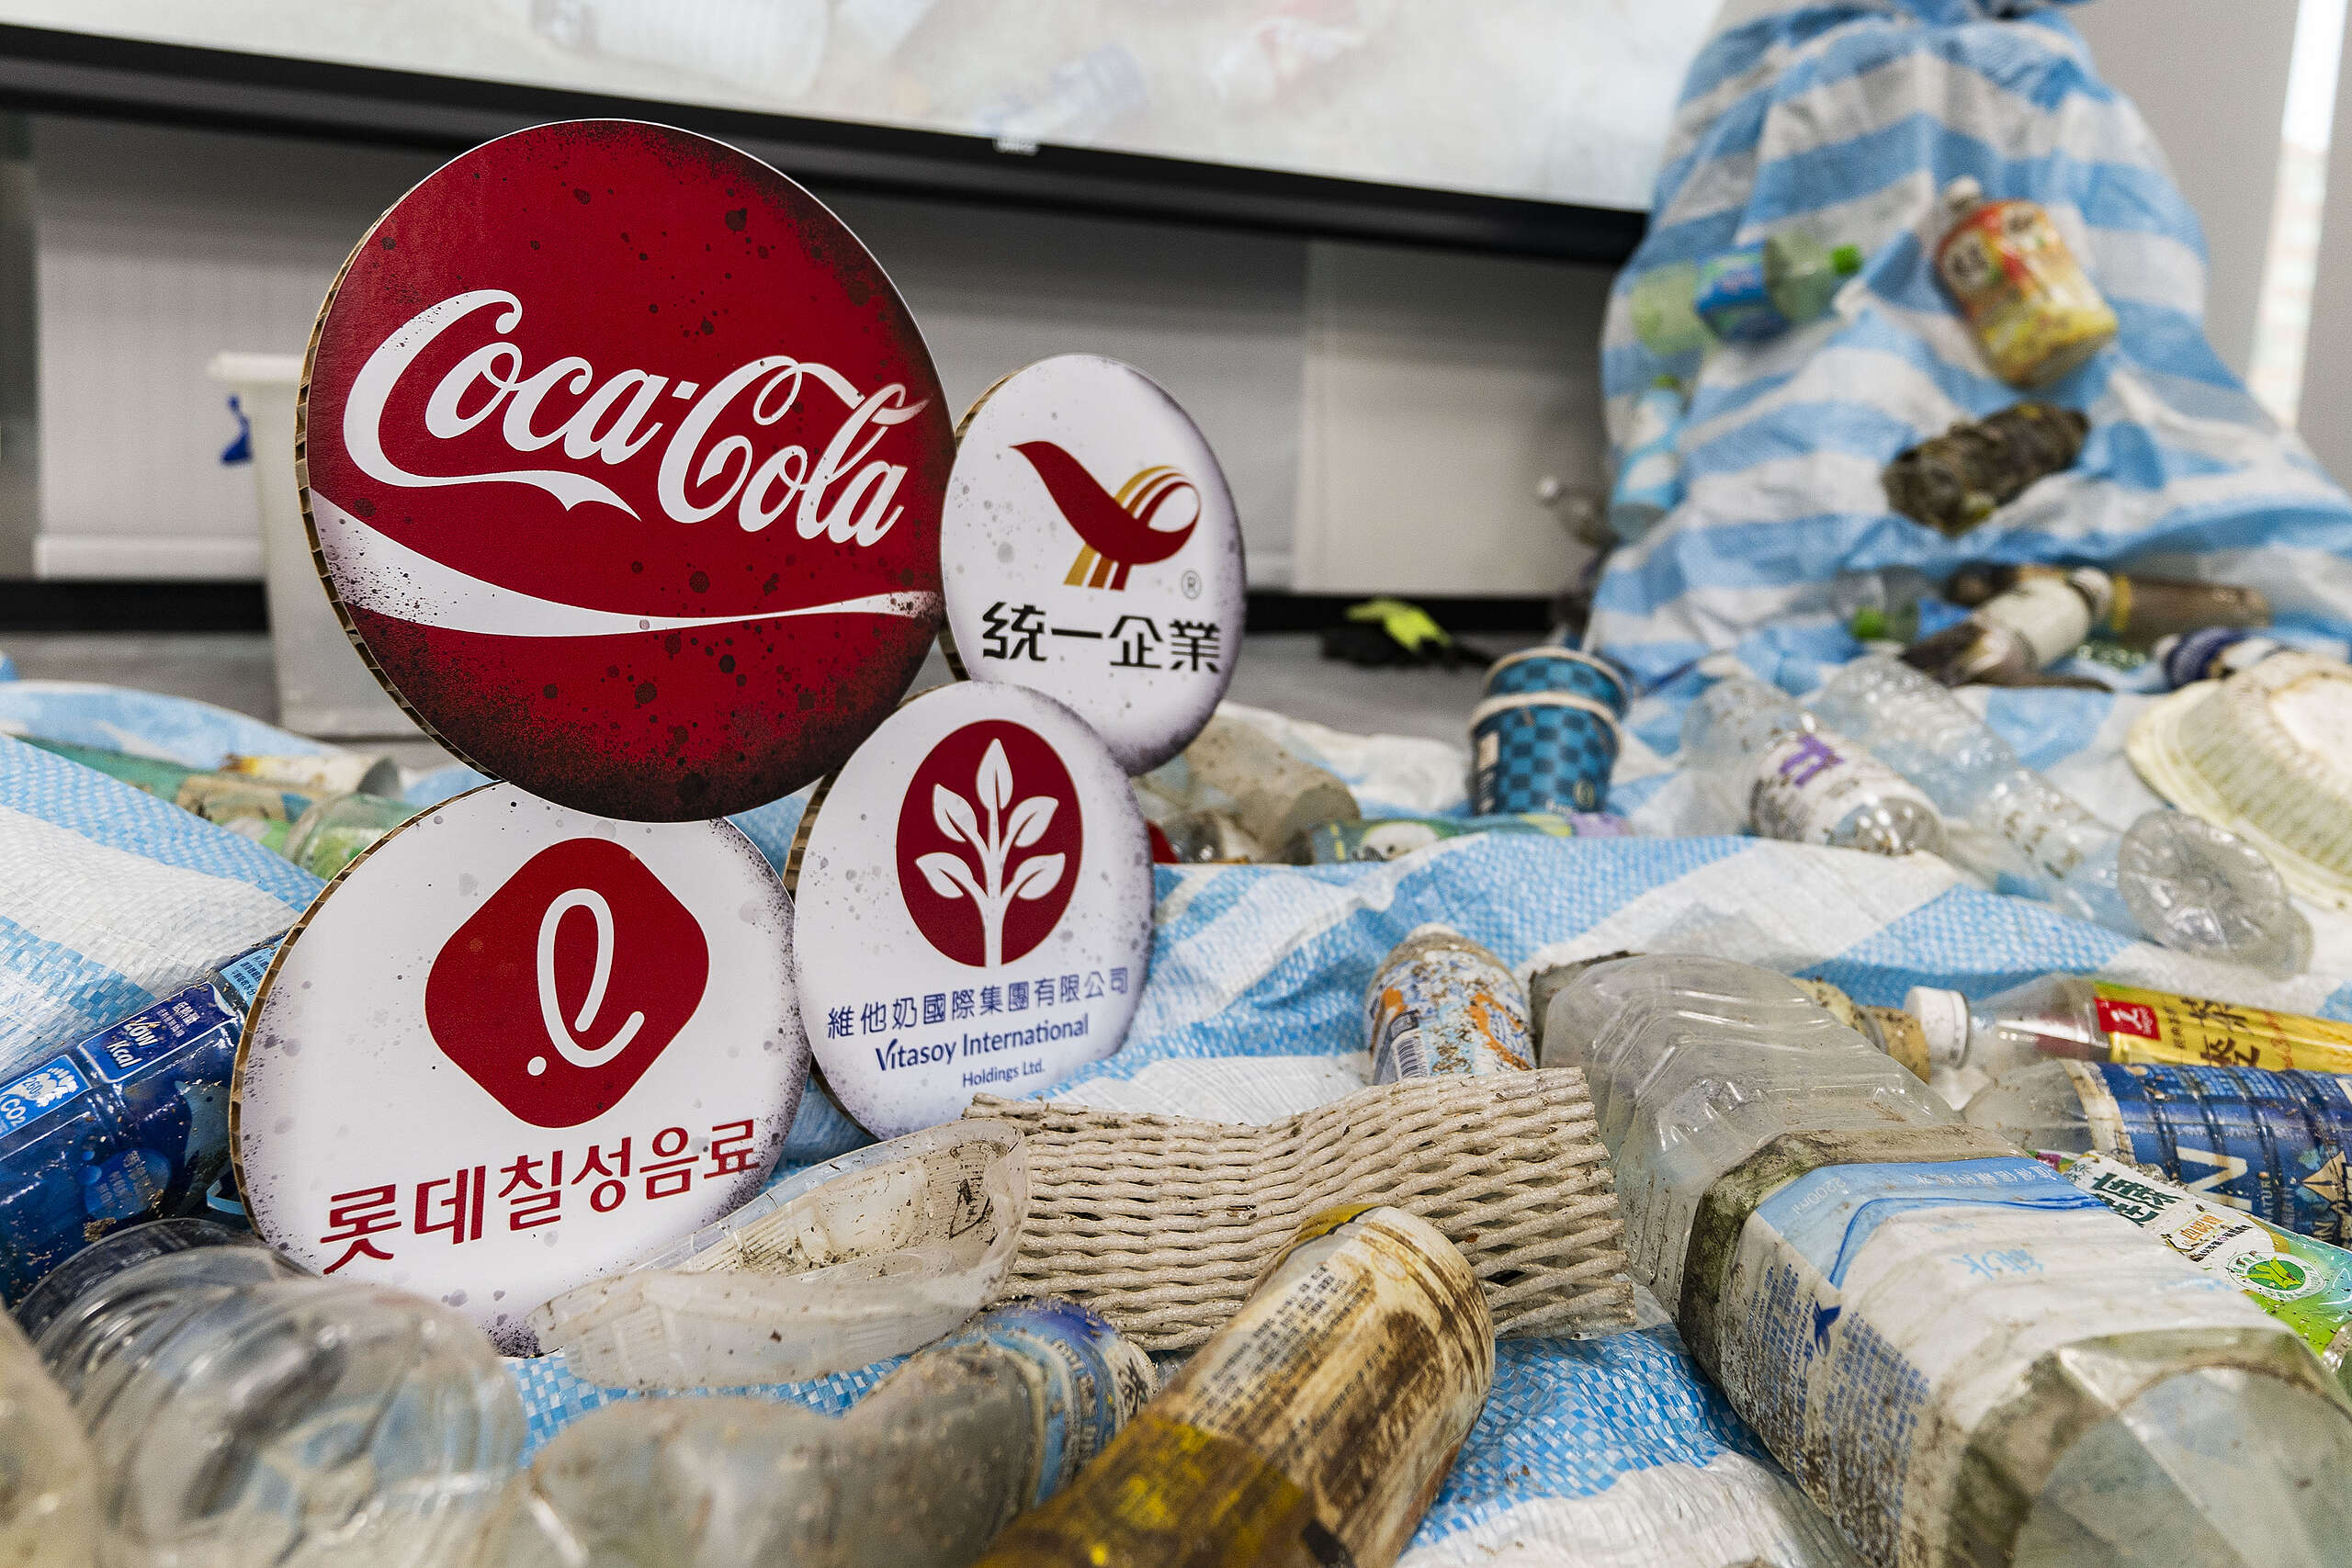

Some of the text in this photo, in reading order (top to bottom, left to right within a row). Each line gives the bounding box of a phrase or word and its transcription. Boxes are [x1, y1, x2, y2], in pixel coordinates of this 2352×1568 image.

[343, 289, 930, 547] Coca-Cola
[981, 602, 1221, 674] 統一企業
[123, 1016, 160, 1048] Low
[826, 966, 1129, 1039] 維他奶國際集團有限公司
[107, 1038, 142, 1070] Kcal
[875, 1013, 1090, 1072] Vitasoy International
[962, 1058, 1046, 1088] Holdings Ltd.
[319, 1118, 761, 1276] 롯데칠성음료
